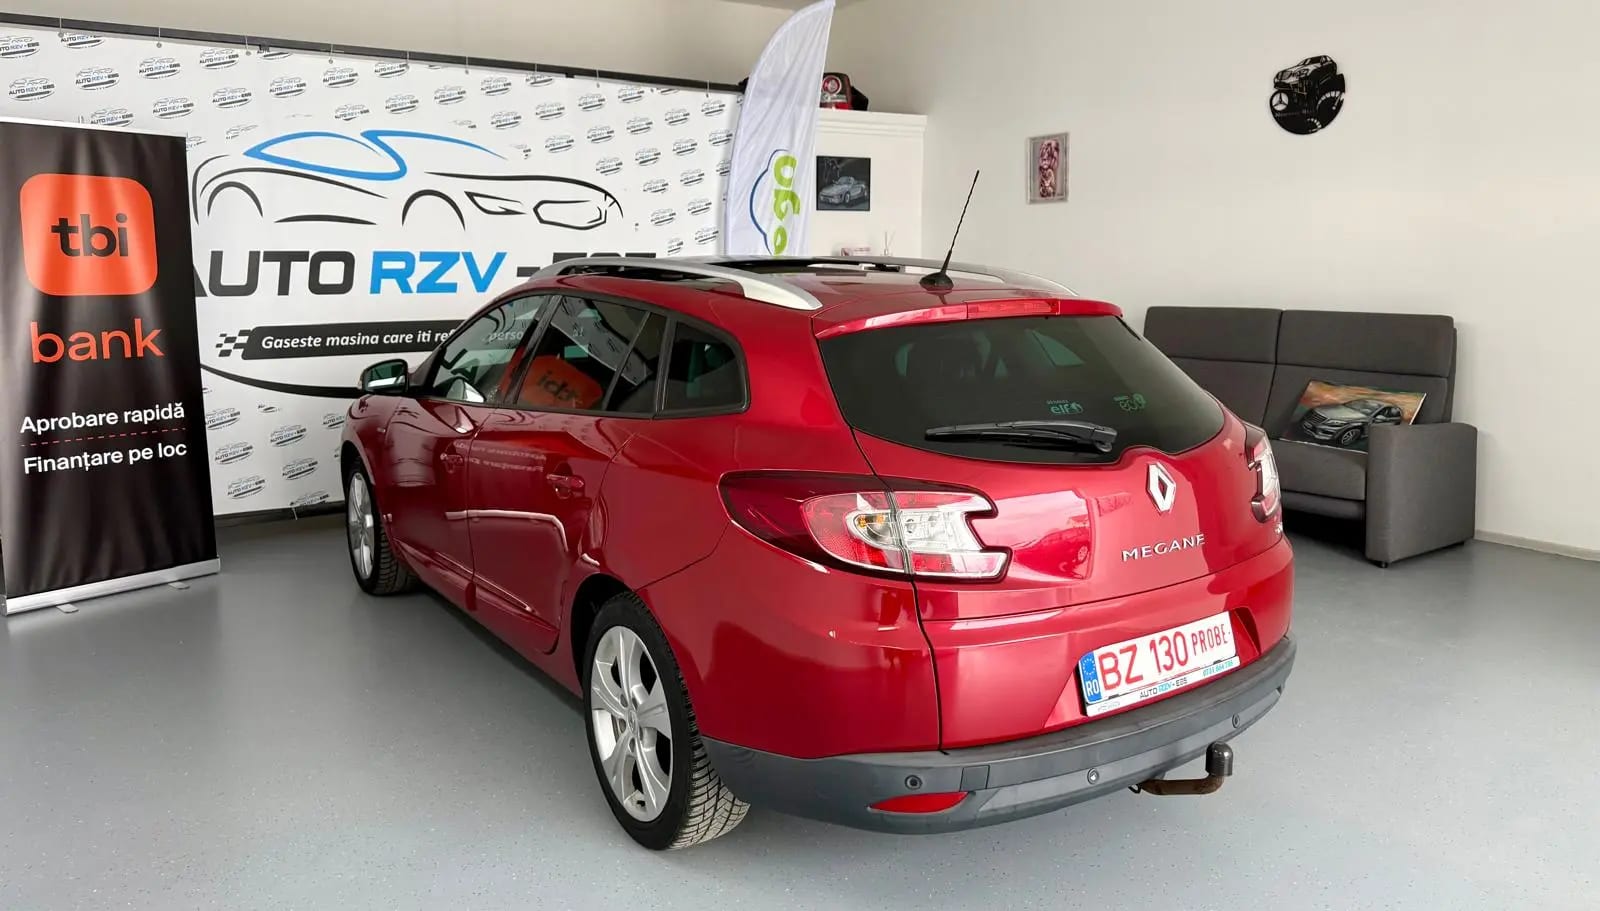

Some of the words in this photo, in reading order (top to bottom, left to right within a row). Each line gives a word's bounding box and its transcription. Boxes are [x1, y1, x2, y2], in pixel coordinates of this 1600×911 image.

[51, 213, 129, 258] tbi
[369, 250, 508, 294] RZV
[30, 318, 164, 365] bank
[261, 331, 322, 350] Gaseste
[325, 332, 379, 347] masina
[383, 330, 413, 345] care
[417, 329, 432, 342] iti
[20, 411, 119, 436] Aprobare
[123, 402, 185, 425] rapidă
[24, 449, 124, 474] Finanțare
[128, 447, 153, 465] pe
[158, 443, 187, 458] loc
[1121, 534, 1205, 562] MEGANE
[1098, 643, 1144, 692] BZ
[1149, 631, 1189, 676] 130
[1191, 623, 1229, 657] PROBE
[1086, 679, 1100, 696] RO
[1140, 687, 1158, 699] AUTO
